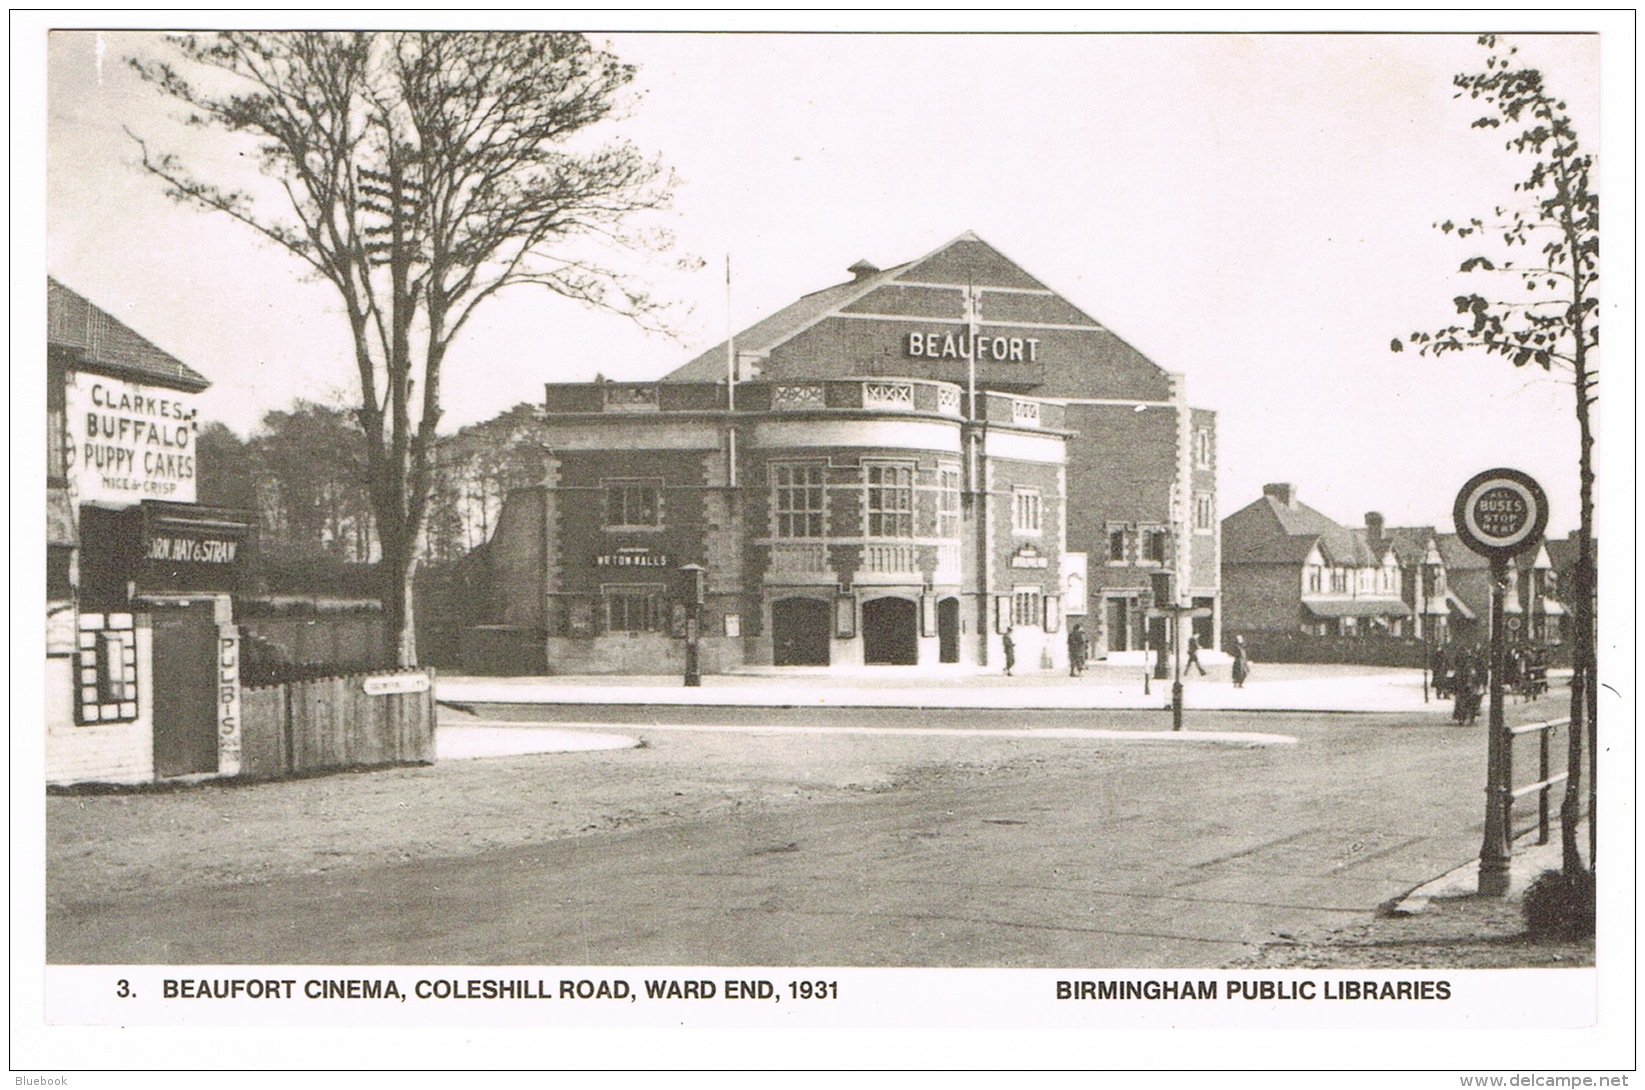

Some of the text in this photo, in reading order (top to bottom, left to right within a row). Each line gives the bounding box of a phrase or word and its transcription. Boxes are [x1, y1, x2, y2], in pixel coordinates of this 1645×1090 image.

[908, 332, 1041, 362] BEAUFORT
[91, 384, 183, 420] CLARKES
[87, 412, 189, 450] BUFFALO
[84, 443, 136, 473] PUPPY
[143, 451, 193, 479] CAKES
[102, 476, 177, 495] NICE & CRISP
[1479, 500, 1522, 513] BUSES
[1484, 513, 1518, 524] STOP
[172, 538, 195, 561] HAY
[193, 543, 202, 561] &
[201, 540, 238, 563] STRAW
